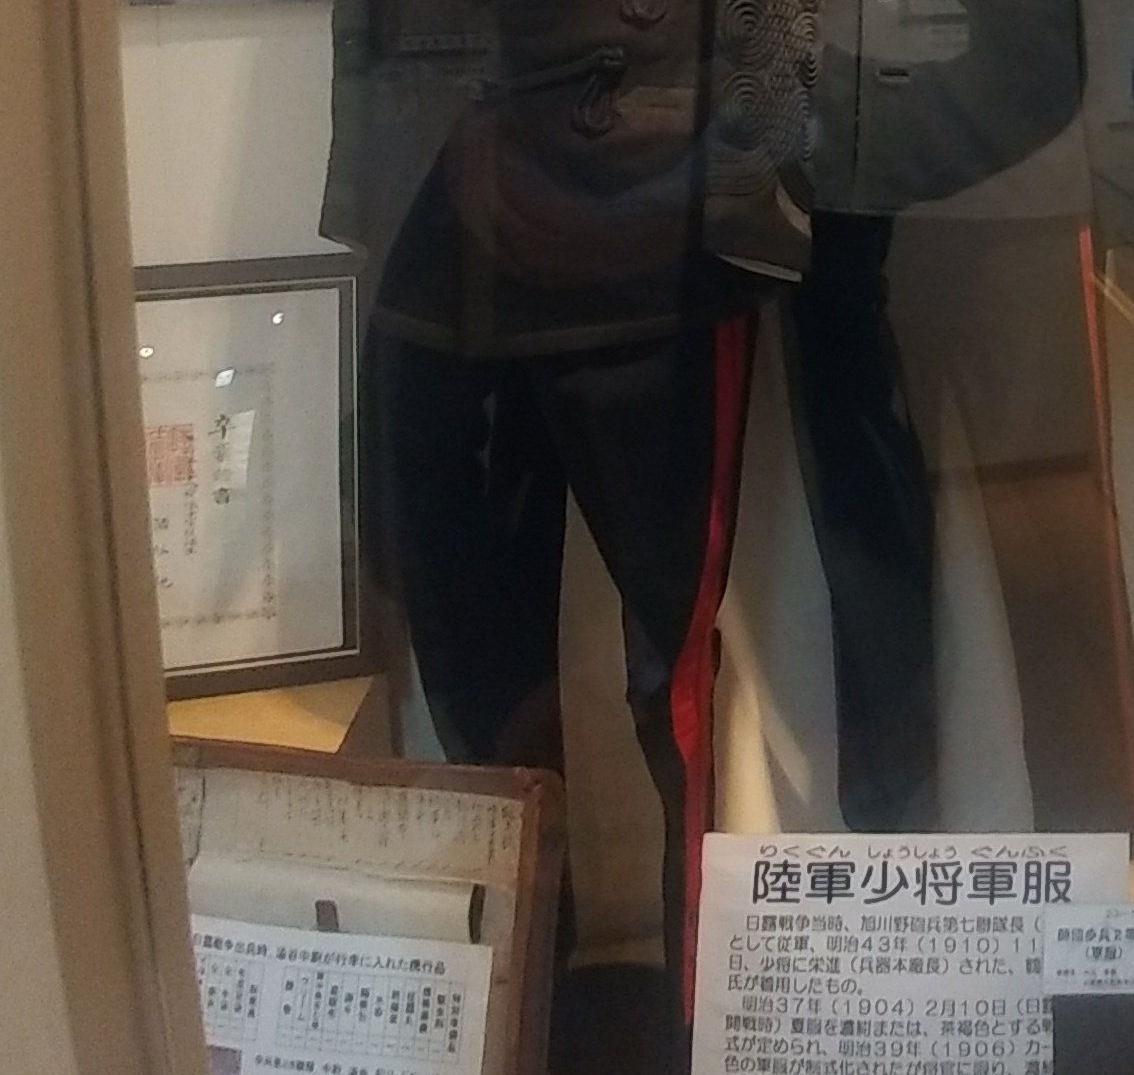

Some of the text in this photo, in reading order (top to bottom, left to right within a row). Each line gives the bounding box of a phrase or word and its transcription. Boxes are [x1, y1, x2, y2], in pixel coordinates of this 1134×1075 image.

[751, 860, 1072, 905] 陸軍少将軍服
